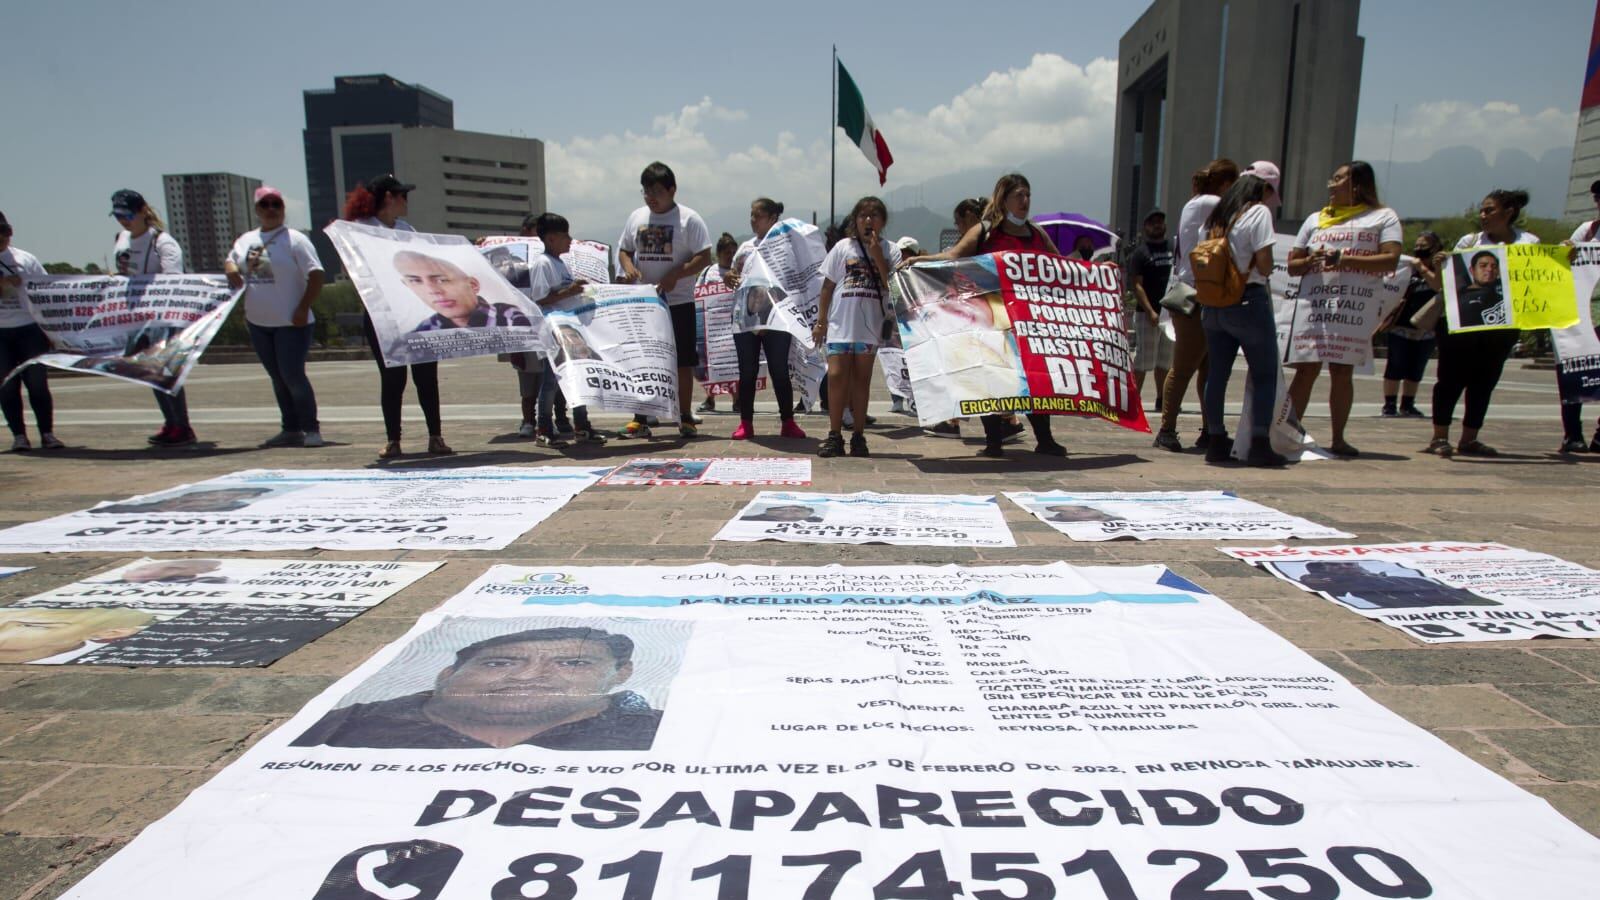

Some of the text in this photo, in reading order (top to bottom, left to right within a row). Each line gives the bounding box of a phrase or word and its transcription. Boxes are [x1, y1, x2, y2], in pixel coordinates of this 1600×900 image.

[1310, 285, 1348, 296] JORGE
[1350, 285, 1374, 298] LUIS
[1312, 300, 1365, 312] AREVALO
[1029, 304, 1104, 326] PORQUE
[1308, 313, 1364, 326] CARRILLO
[1028, 338, 1131, 372] HASTA SABE
[1045, 356, 1129, 412] DE TI
[961, 400, 998, 414] ERICK
[1001, 398, 1030, 411] IVAN
[1033, 398, 1078, 411] RANGEL
[1467, 620, 1600, 634] 8117
[966, 658, 1029, 667] MORENA
[857, 700, 965, 712] VESTIMENTA:
[988, 703, 1072, 712] CHAMARA
[1058, 710, 1080, 720] DE
[771, 722, 1198, 732] LUGAR DE LOS HECHOS: TAMAULIPAS
[261, 759, 362, 772] RESUMEN
[370, 764, 400, 772] DE
[405, 764, 447, 772] LOS
[452, 761, 546, 774] HECHOS:
[554, 764, 580, 774] SE
[587, 766, 624, 774] VIO
[632, 762, 677, 774] POR
[685, 764, 768, 775] ULTIMA
[778, 764, 819, 774] VEZ
[827, 764, 850, 774] EL
[888, 758, 914, 772] DE
[922, 762, 1016, 773] FEBRERO
[1137, 764, 1166, 774] EN
[1170, 760, 1268, 773] REYNOSA
[414, 784, 1305, 832] DESAPARECIDO
[488, 846, 1433, 900] 8117451250
